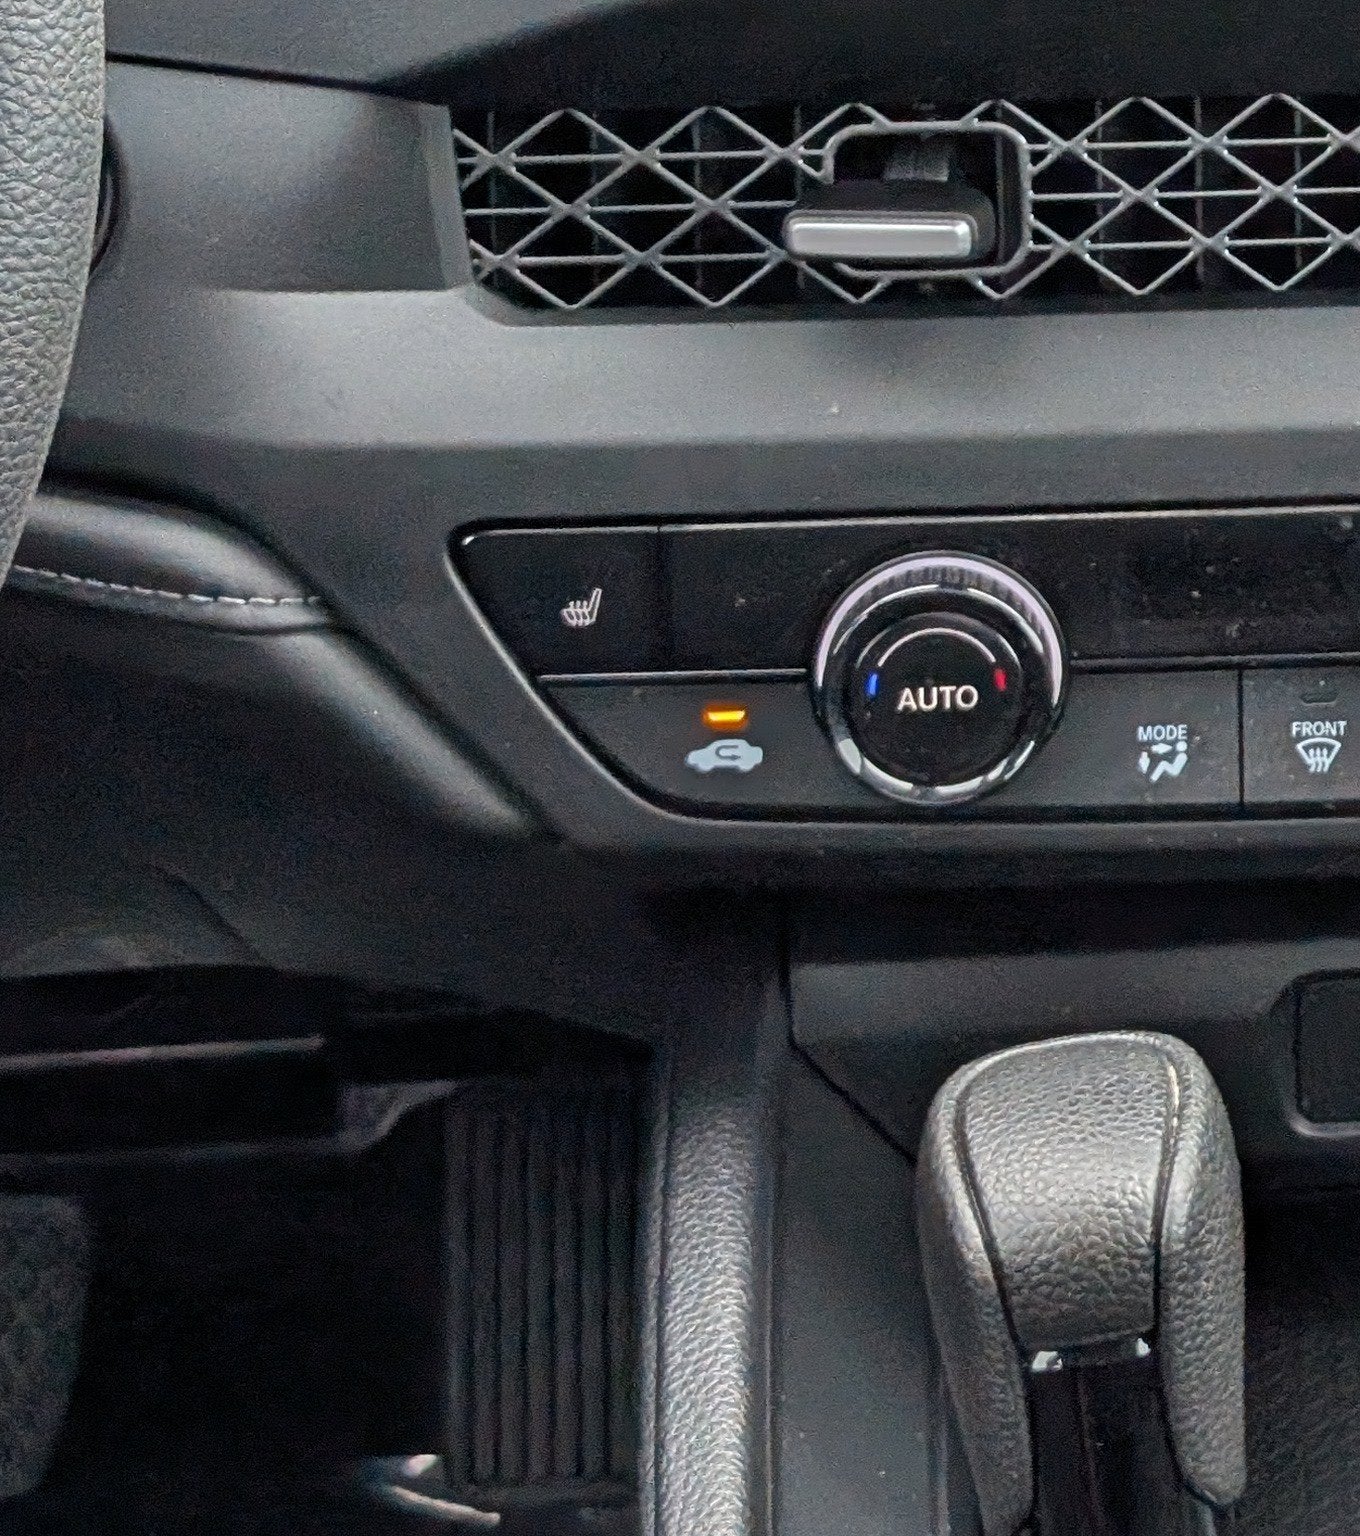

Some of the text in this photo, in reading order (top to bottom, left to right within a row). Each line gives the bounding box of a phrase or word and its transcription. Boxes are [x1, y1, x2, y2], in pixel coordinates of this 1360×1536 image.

[896, 684, 980, 712] AUTO
[1137, 724, 1188, 742] MODE
[1291, 720, 1347, 738] FRONT
